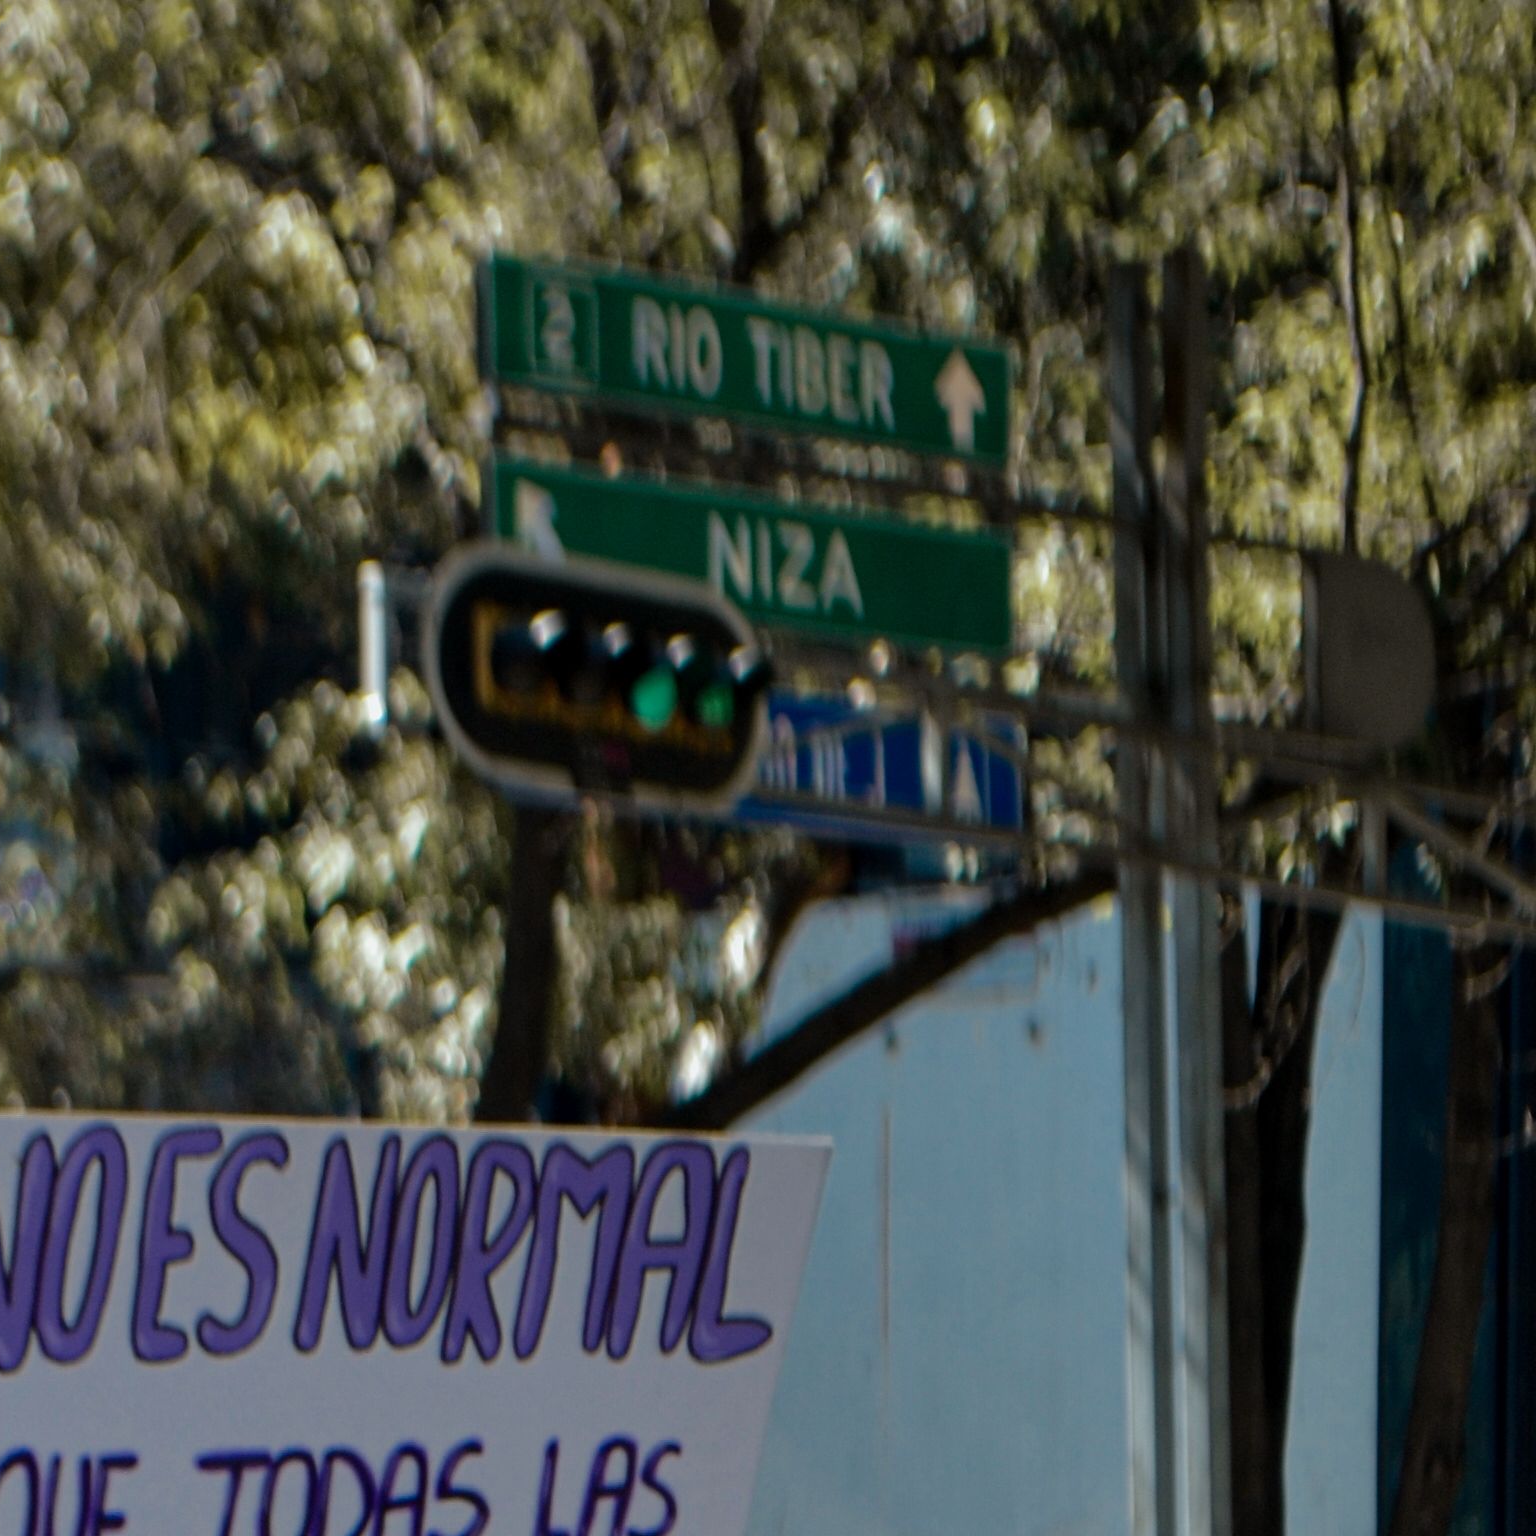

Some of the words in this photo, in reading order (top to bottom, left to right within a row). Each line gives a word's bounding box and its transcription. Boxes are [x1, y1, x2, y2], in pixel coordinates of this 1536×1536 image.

[631, 294, 724, 397] RIO
[745, 314, 895, 432] TIBER
[708, 509, 864, 618] NIZA
[131, 1125, 289, 1363] ES
[292, 1132, 775, 1367] NORMAL
